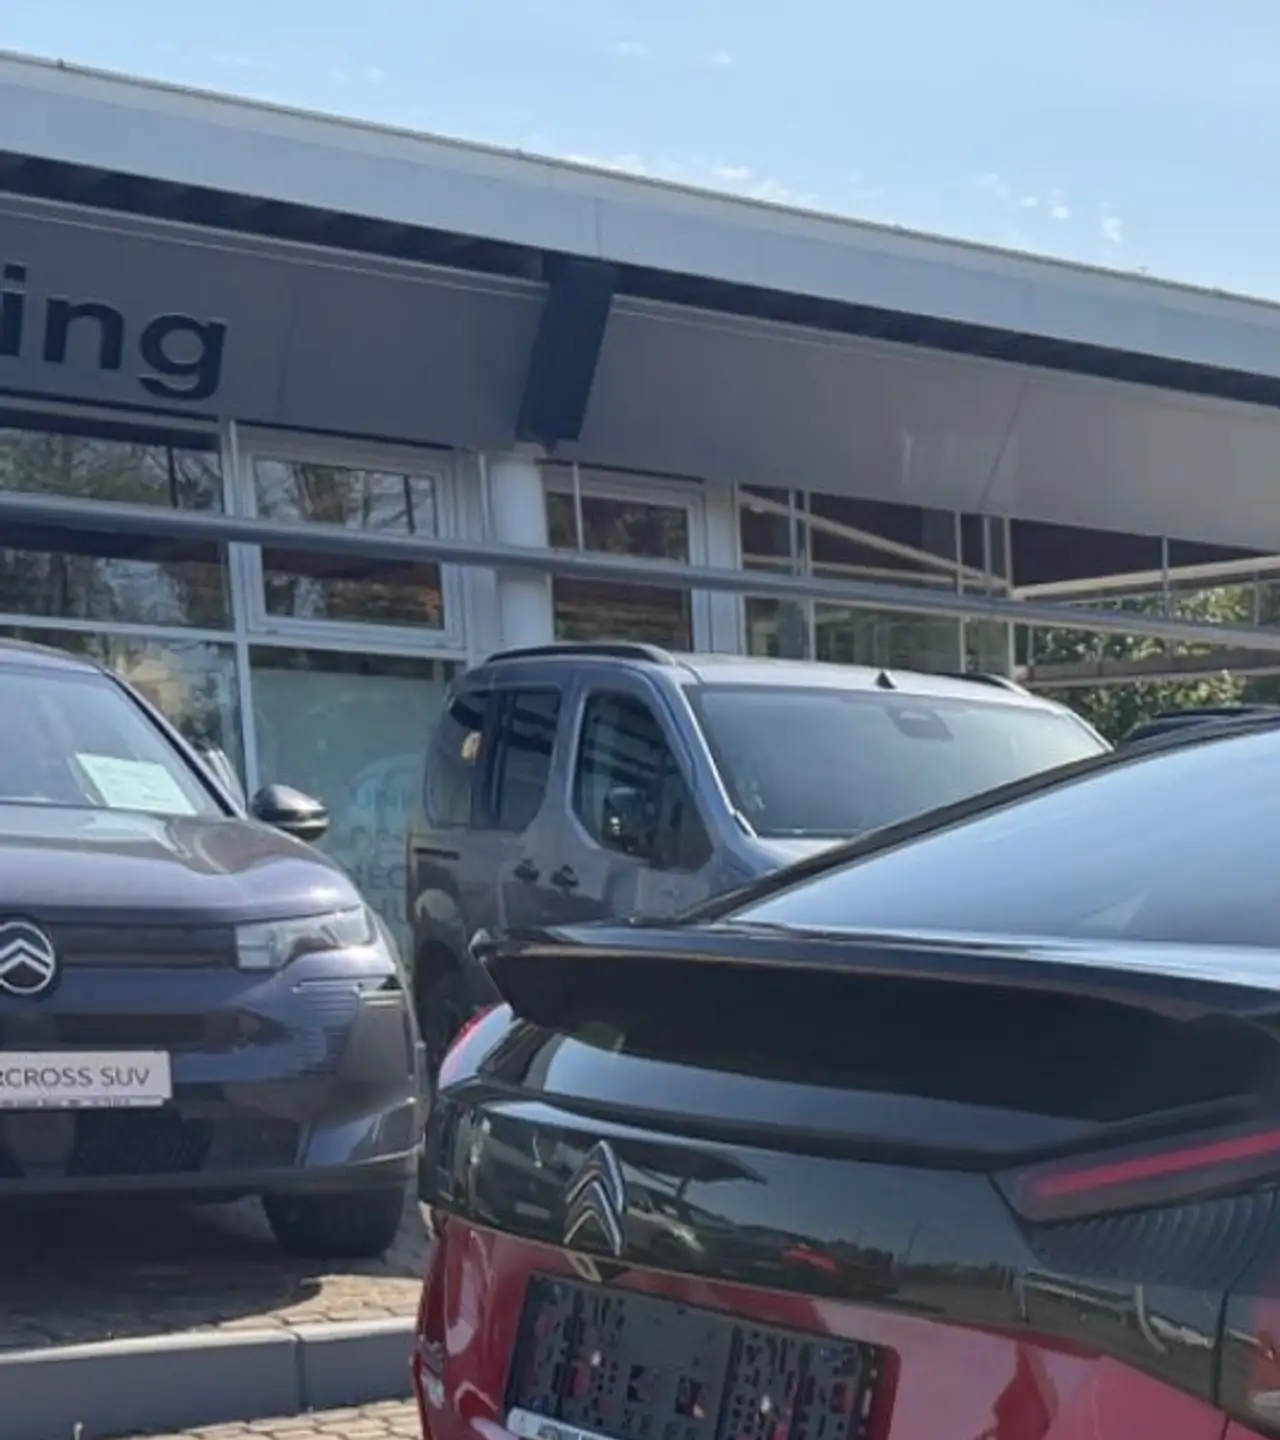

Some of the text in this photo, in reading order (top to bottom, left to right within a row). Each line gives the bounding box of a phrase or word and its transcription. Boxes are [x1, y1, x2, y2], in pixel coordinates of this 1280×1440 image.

[0, 264, 227, 401] ing
[0, 1067, 150, 1088] CROSS SUV
